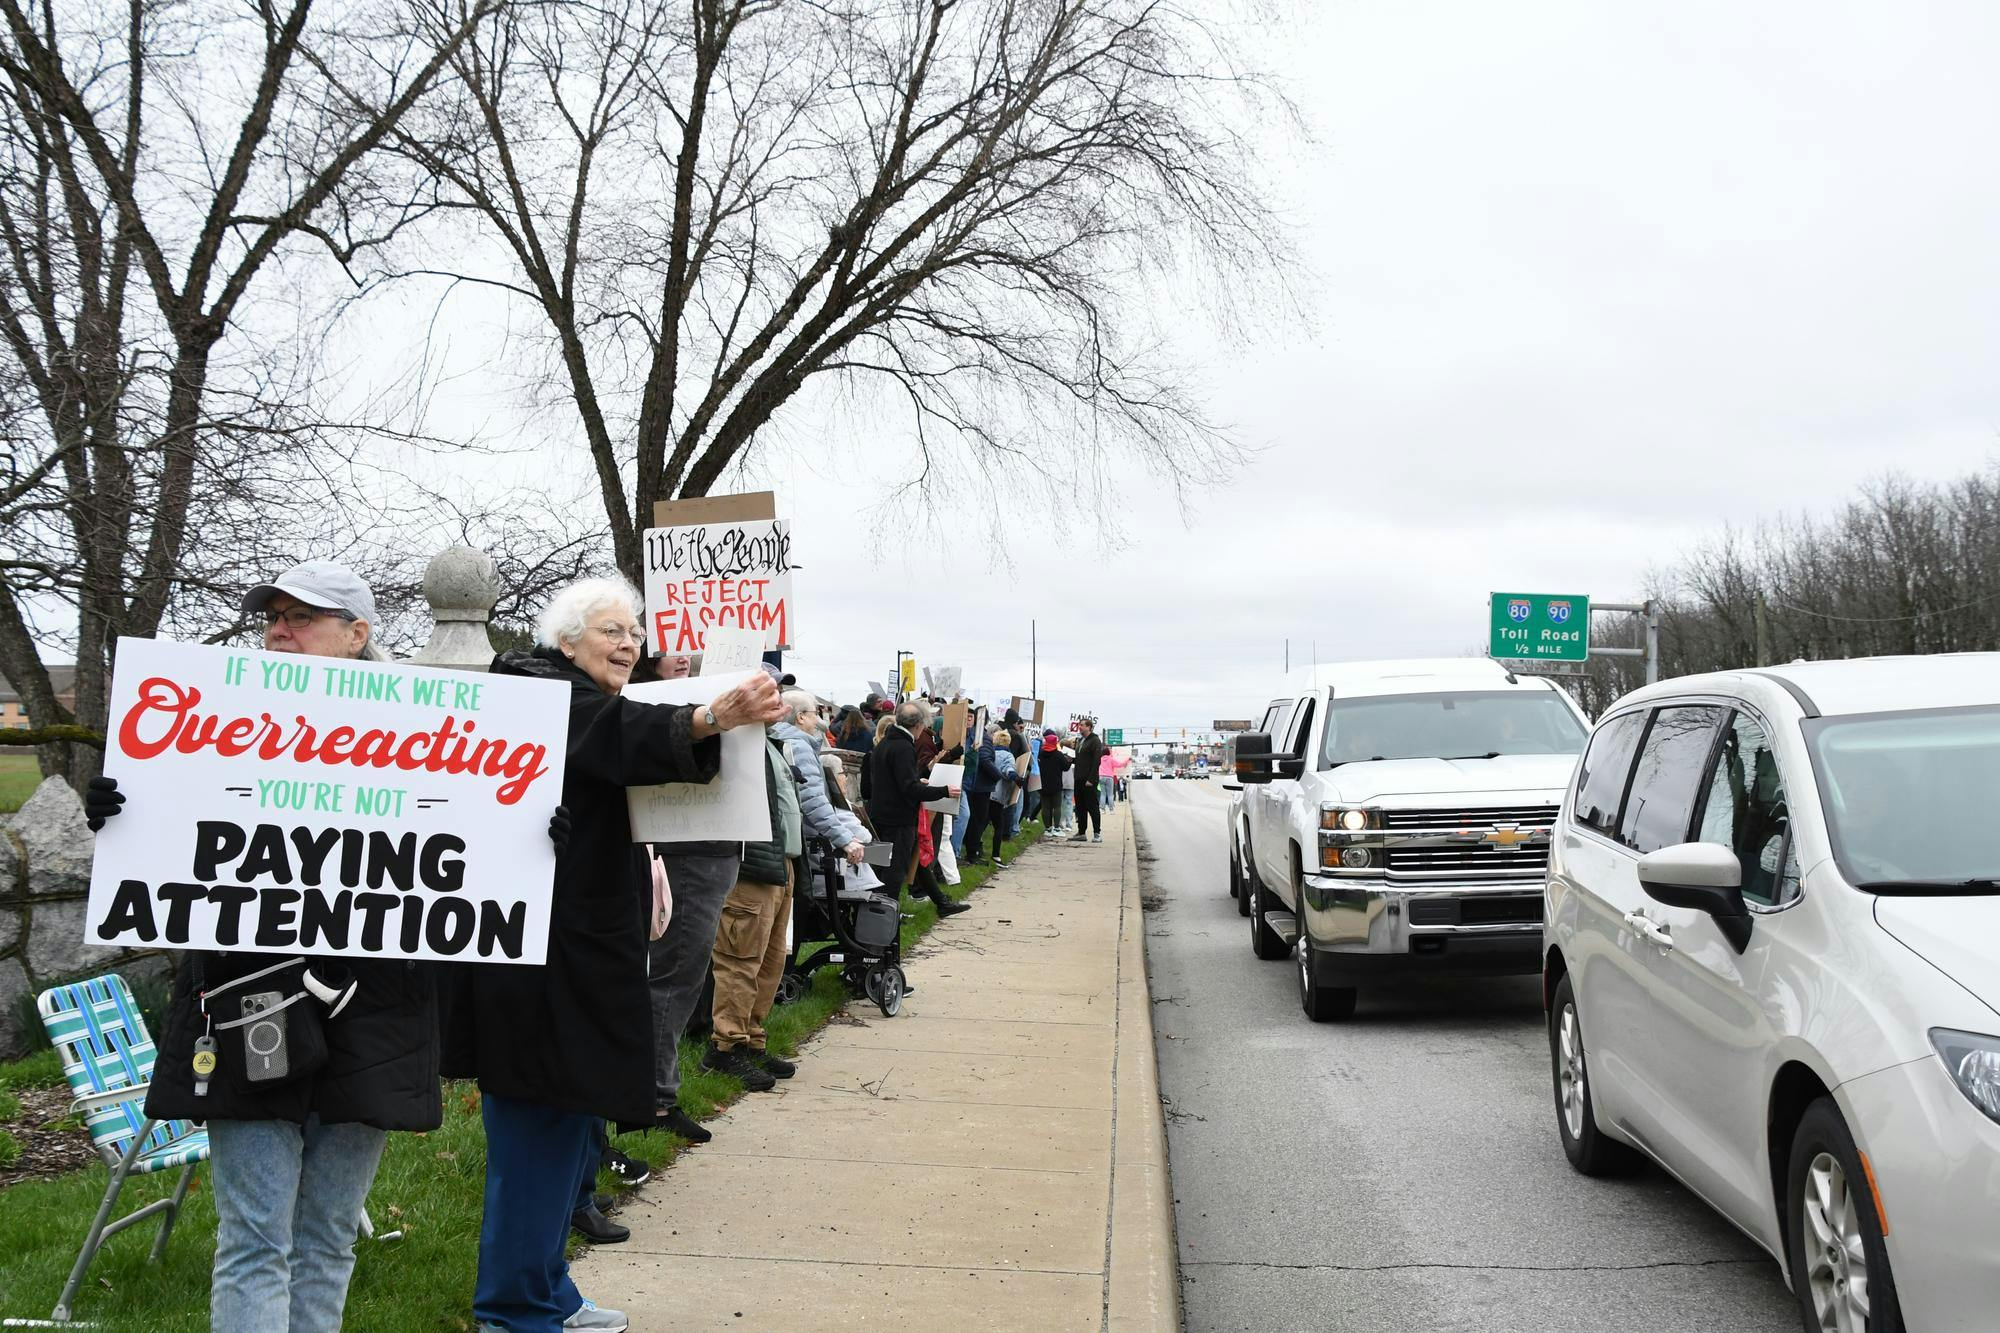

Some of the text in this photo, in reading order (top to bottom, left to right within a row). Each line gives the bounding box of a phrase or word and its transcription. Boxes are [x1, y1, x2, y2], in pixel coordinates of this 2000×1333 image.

[646, 528, 686, 575] We
[722, 520, 791, 580] People
[666, 579, 770, 606] REJECT
[1510, 605, 1529, 618] 80
[1549, 606, 1569, 619] 90
[1499, 627, 1579, 641] Toll Road
[1537, 645, 1562, 654] MILE
[225, 656, 485, 711] IF YOU THINK WE'RE
[118, 676, 549, 806] Overreacting
[257, 778, 408, 818] YOU'RE NOT
[192, 820, 466, 892] PAYING
[97, 879, 527, 959] ATTENTION
